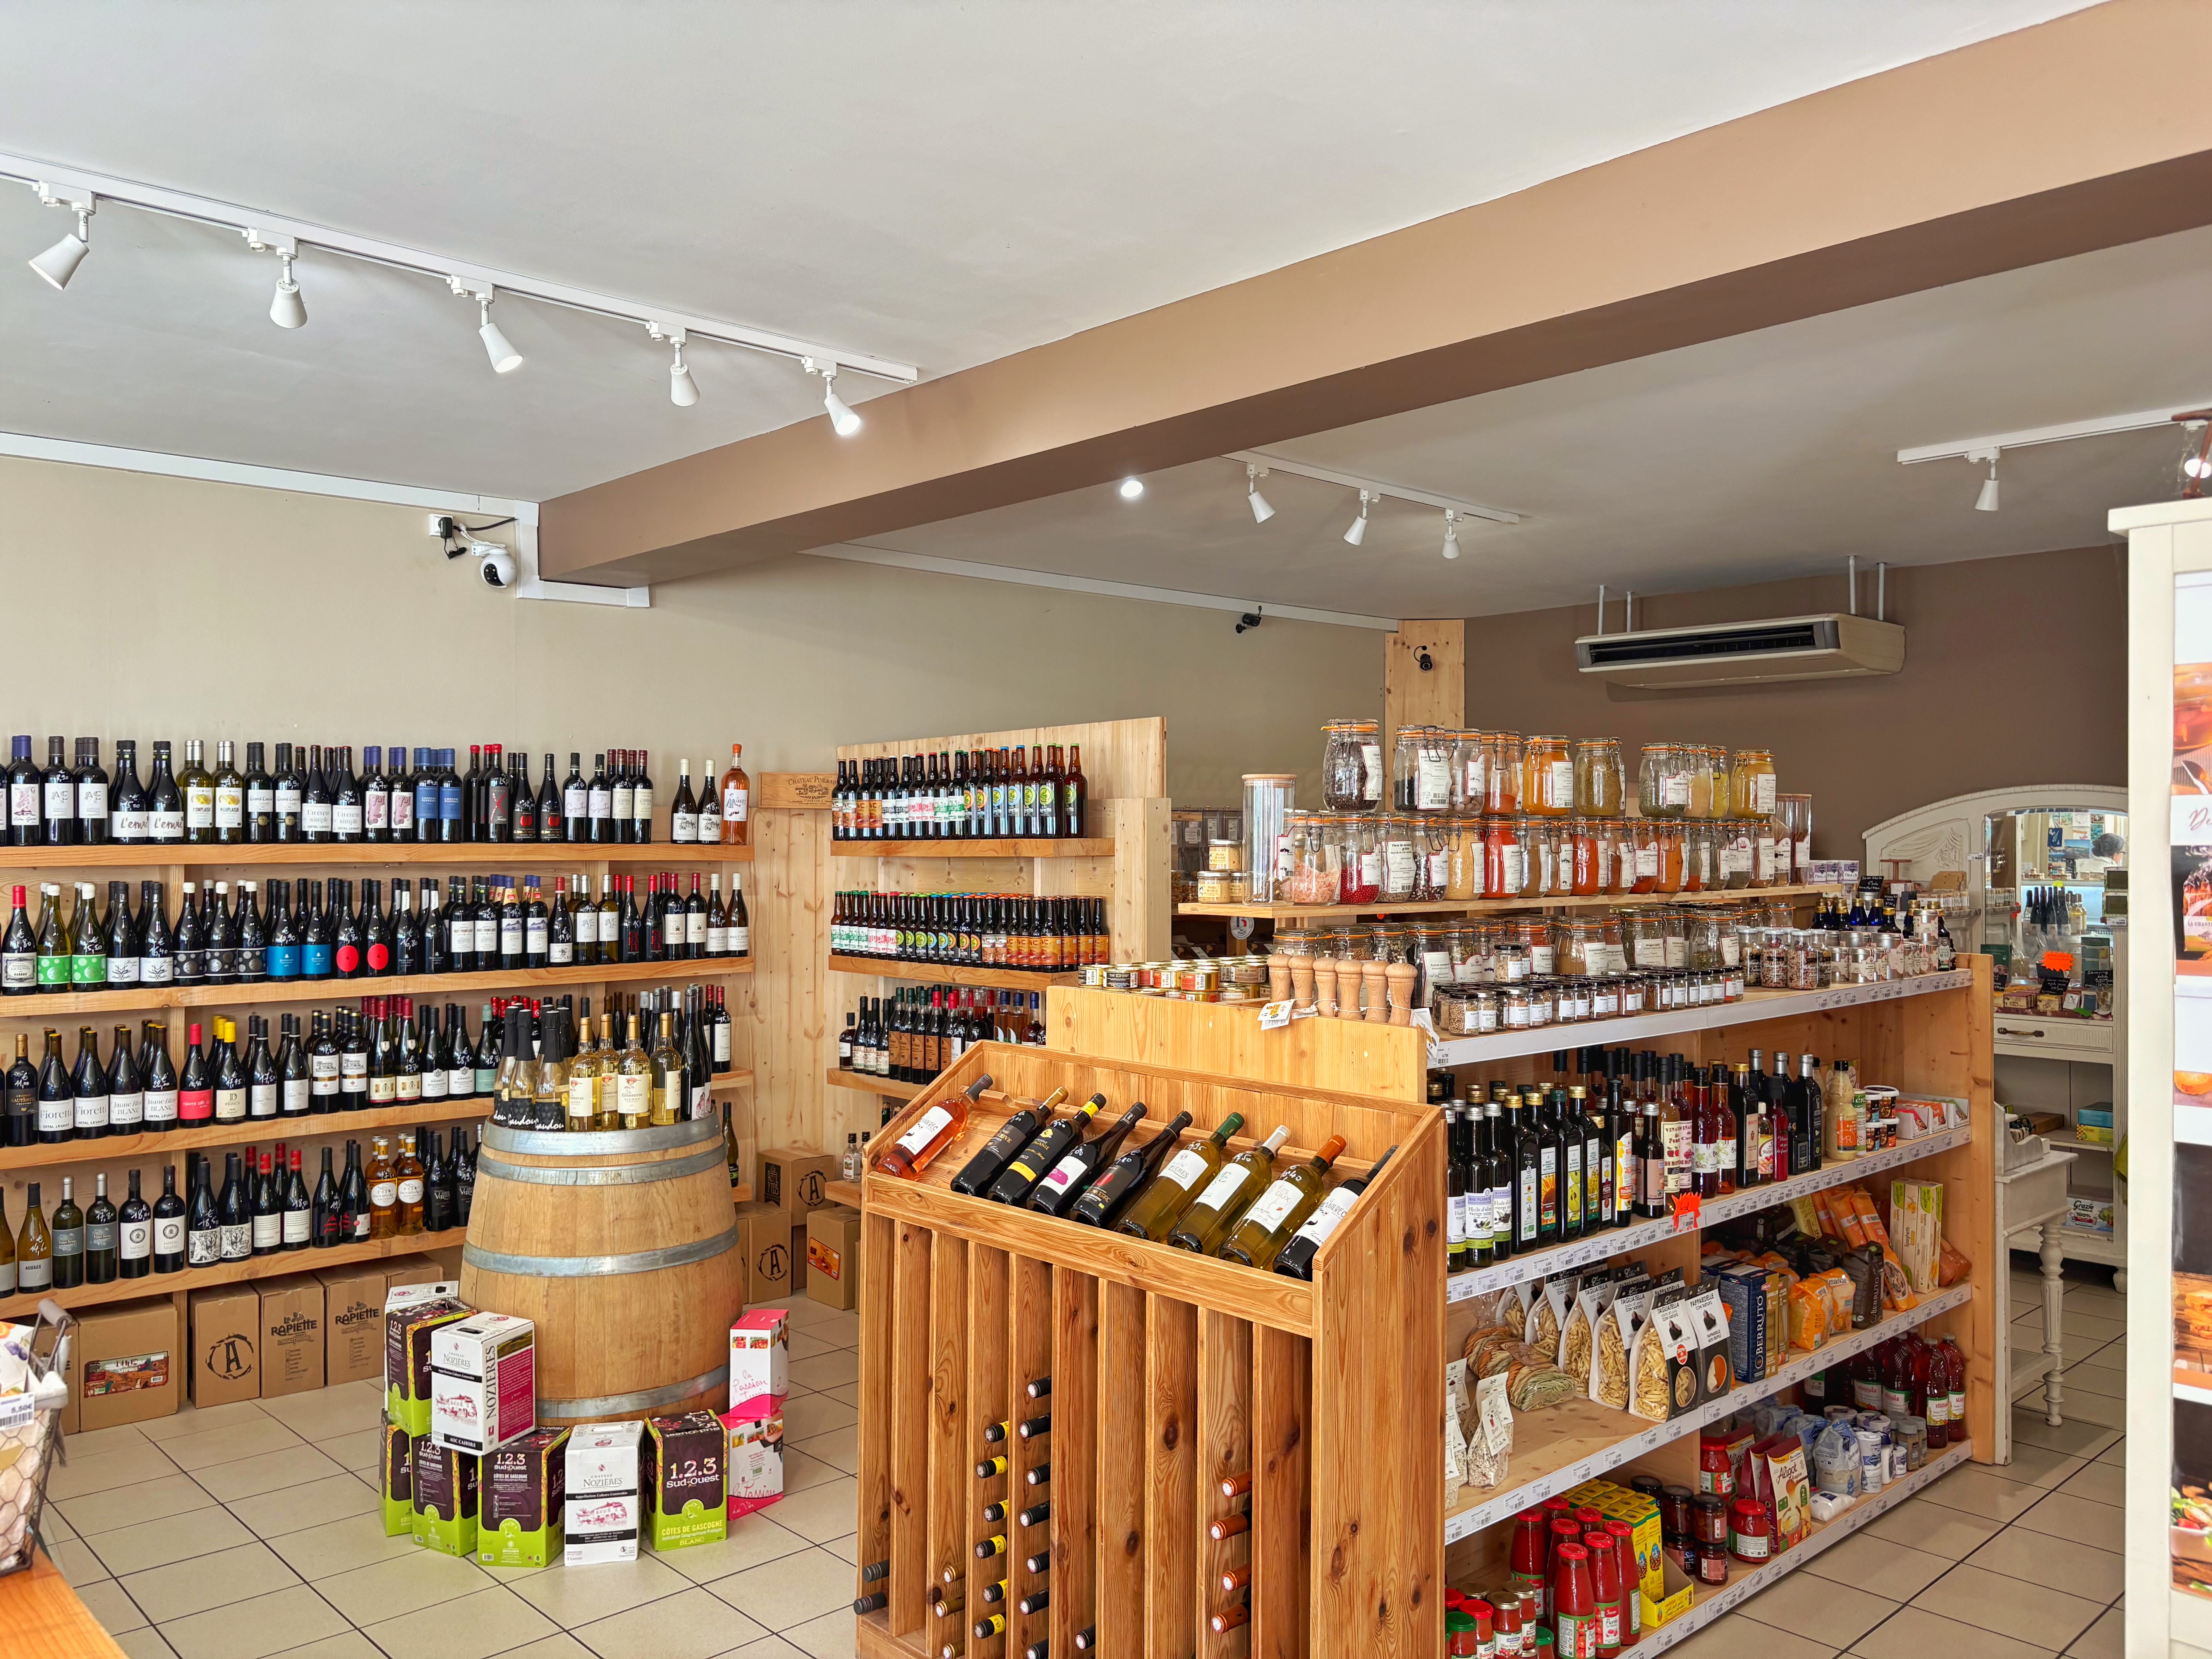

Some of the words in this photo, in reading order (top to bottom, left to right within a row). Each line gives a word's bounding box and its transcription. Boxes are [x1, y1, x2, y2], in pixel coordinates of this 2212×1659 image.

[155, 817, 183, 829] L'envie
[400, 937, 419, 950] 16,80
[40, 1109, 72, 1119] Fioretti
[76, 1105, 107, 1115] Fioretti
[809, 1173, 821, 1200] A
[1325, 1202, 1347, 1218] MALBEC
[2074, 1200, 2095, 1211] Grazie
[769, 1249, 782, 1276] A
[1621, 1294, 1645, 1305] TAGLIATELLA
[1690, 1293, 1714, 1307] PAPPARDELLE
[1657, 1302, 1680, 1314] TAGLIATELLA
[336, 1308, 379, 1325] RAPIETTE
[271, 1320, 317, 1336] RAPIETTE
[225, 1341, 243, 1373] A
[733, 1379, 768, 1392] Passion
[11, 1403, 33, 1413] 5,50€
[421, 1441, 441, 1455] 1.2.3
[459, 1439, 476, 1448] CAHORS
[496, 1453, 525, 1465] 1.2.3
[1729, 1451, 1744, 1466] Aligo
[670, 1457, 716, 1479] 1.2.3
[1777, 1463, 1798, 1484] Aligot
[584, 1477, 622, 1487] NOZIÈRES
[666, 1474, 720, 1488] Sud-Ouest
[662, 1526, 682, 1536] CÔTES
[692, 1520, 723, 1532] GASCOGNE
[679, 1537, 705, 1546] BLANC
